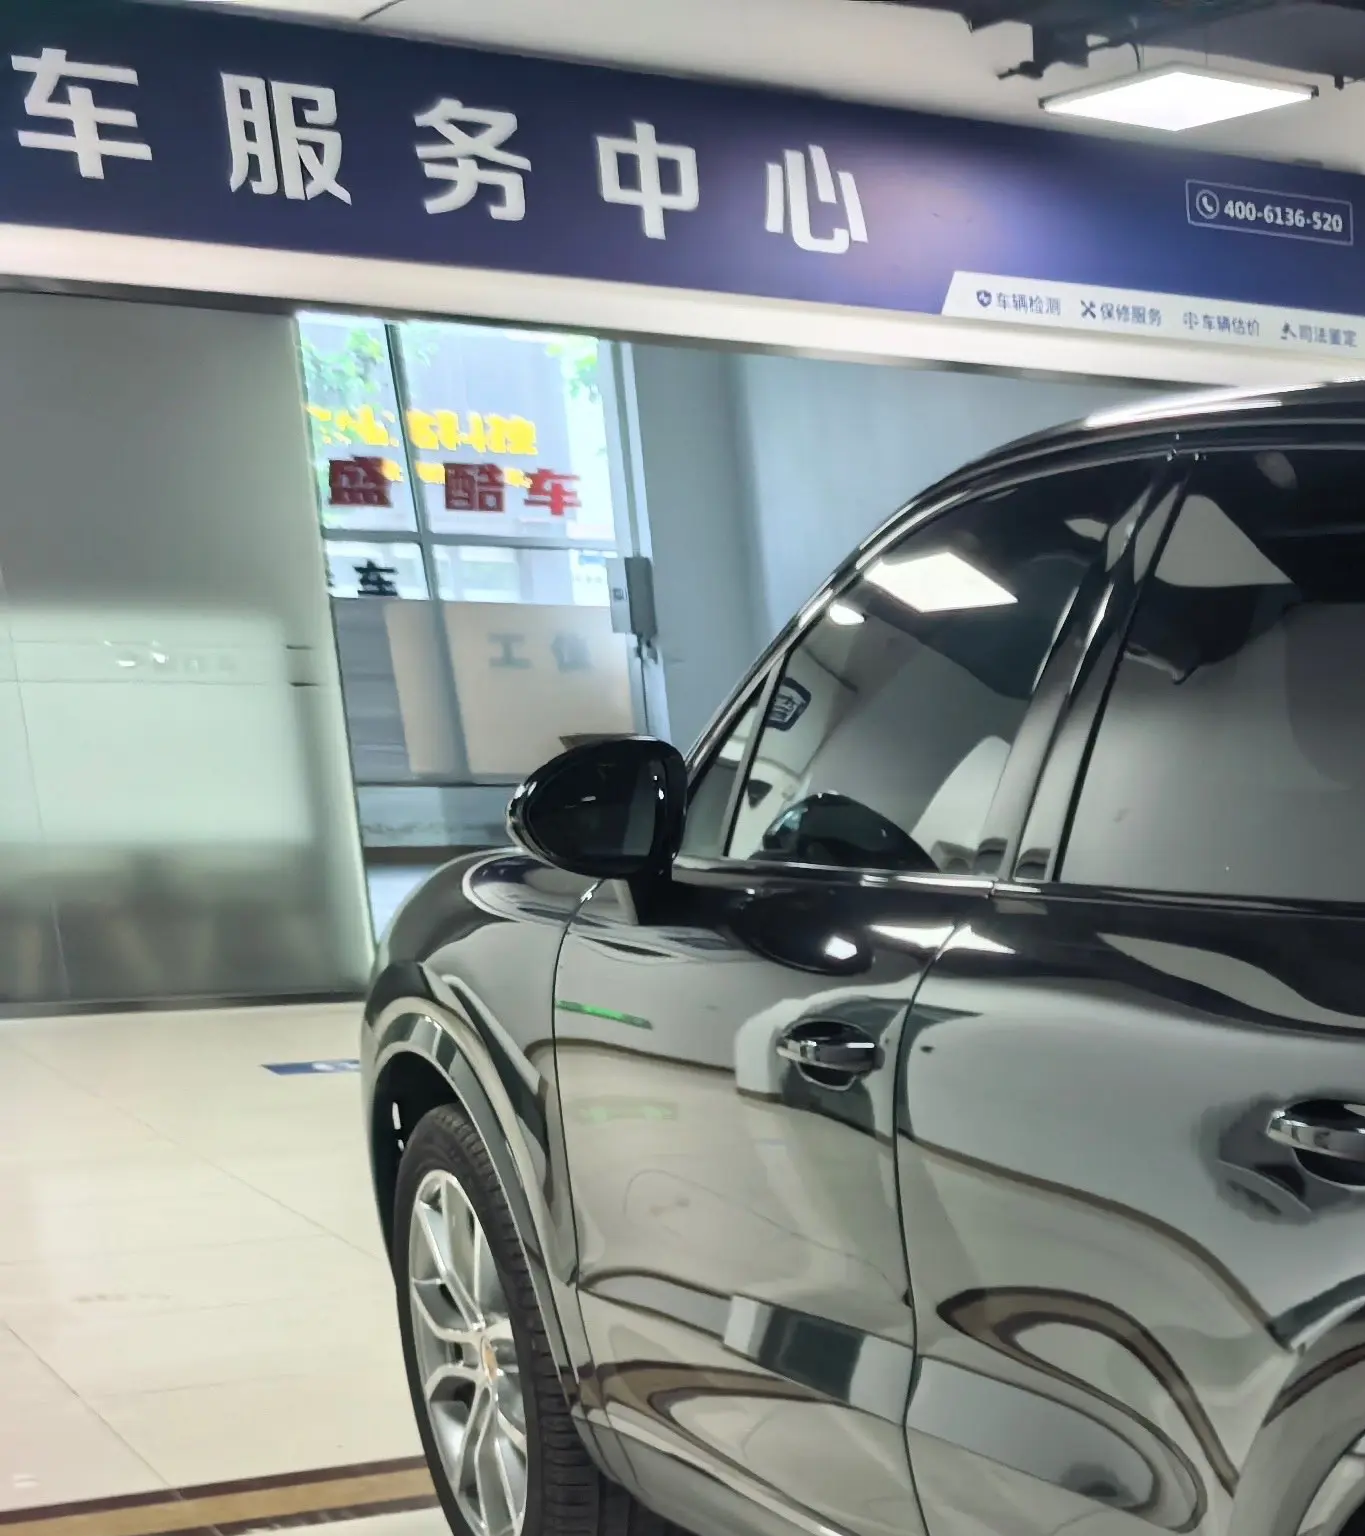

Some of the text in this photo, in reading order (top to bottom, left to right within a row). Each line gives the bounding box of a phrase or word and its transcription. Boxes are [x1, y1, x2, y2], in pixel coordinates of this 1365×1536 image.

[11, 47, 869, 255] 车服务中心
[1223, 199, 1344, 233] 400-6136-520
[996, 292, 1062, 316] 车辆检测
